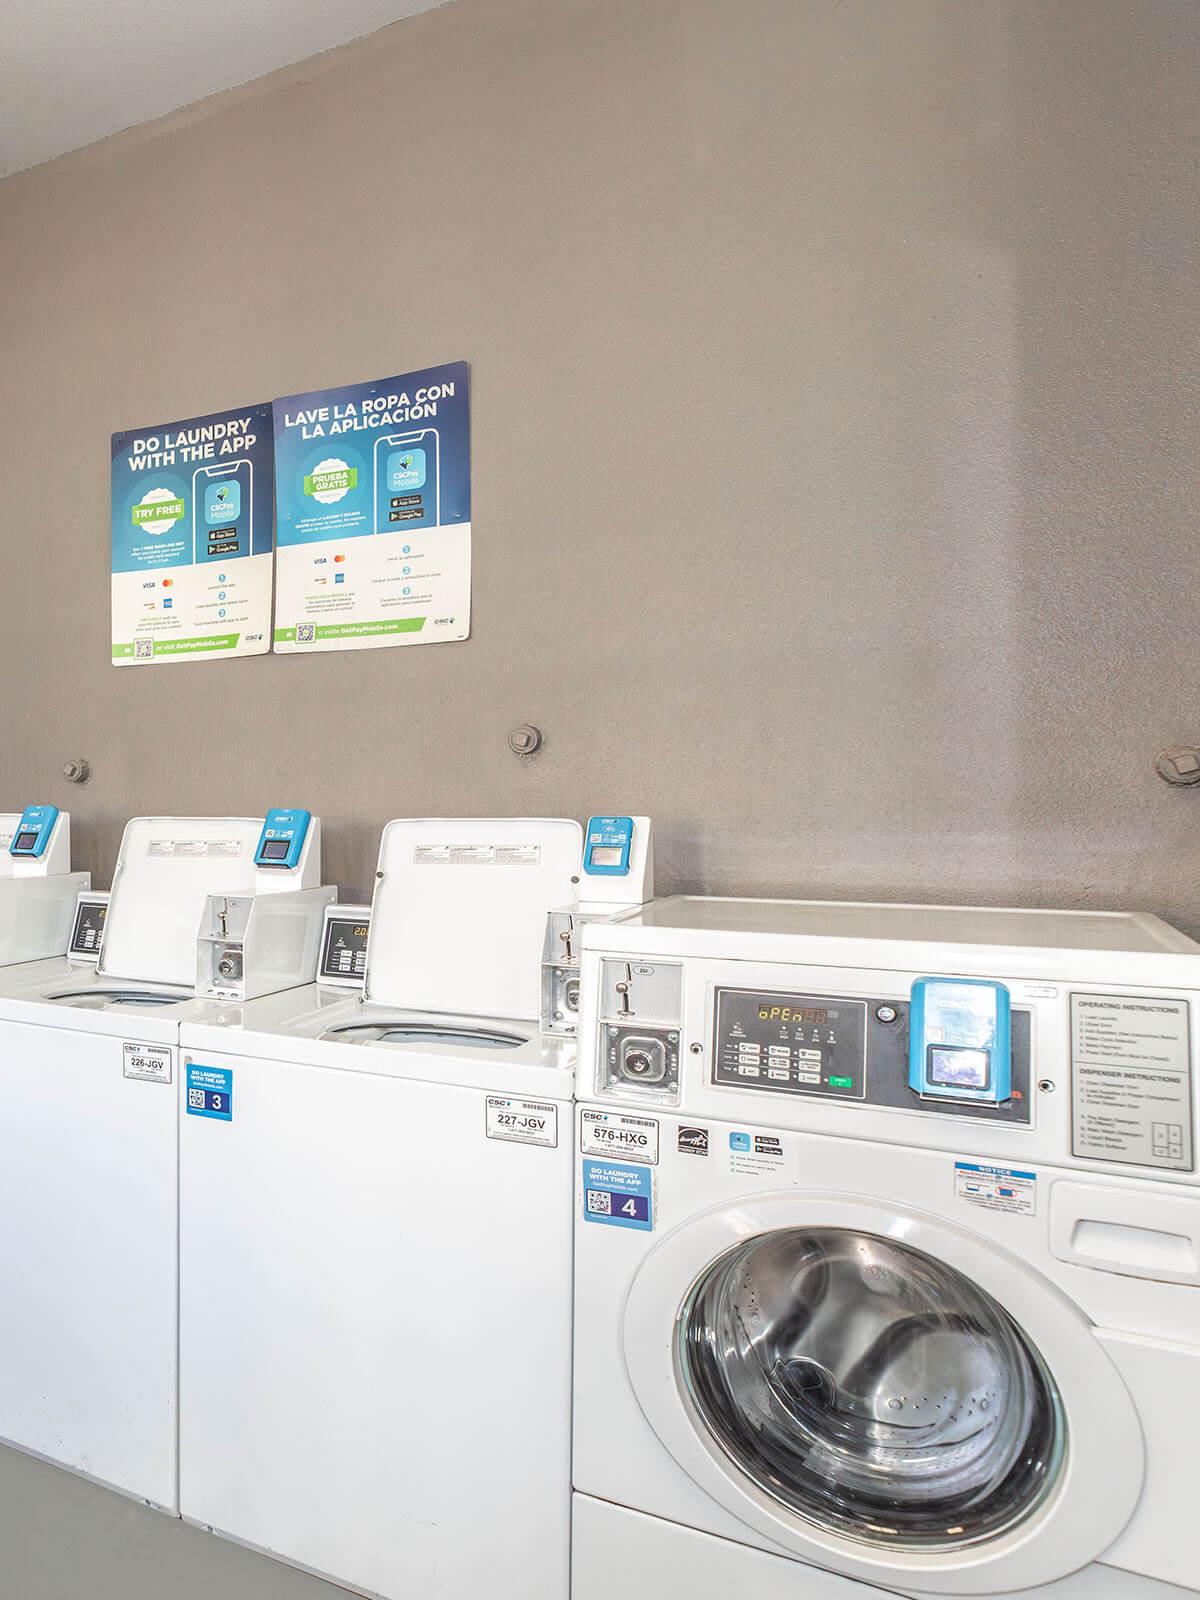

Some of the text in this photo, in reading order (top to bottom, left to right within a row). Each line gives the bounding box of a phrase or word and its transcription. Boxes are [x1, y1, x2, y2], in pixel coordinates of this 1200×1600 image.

[284, 382, 455, 427] LAVE LA ROPA CON
[301, 401, 437, 440] LA APLICACIÓN
[134, 417, 252, 454] DO LAUNDRY
[128, 435, 257, 471] WITH THE APP
[312, 471, 349, 484] PRUEBA
[315, 479, 348, 491] GRATIS
[135, 504, 182, 519] TRY FREE
[1079, 1001, 1180, 1014] OPERATING INSTRUCTIONS
[131, 1057, 164, 1069] 226-JGV
[1080, 1069, 1181, 1084] DISPENSER INSTRUCTIONS
[212, 1094, 222, 1109] 3
[497, 1114, 546, 1129] 227-JGV
[583, 1112, 603, 1121] CSC
[593, 1128, 648, 1146] 576-HXG
[591, 1167, 640, 1180] DO LAUNDRY
[978, 1165, 1011, 1176] NOTICE
[589, 1173, 642, 1186] WITH THE APP
[621, 1198, 637, 1217] 4
